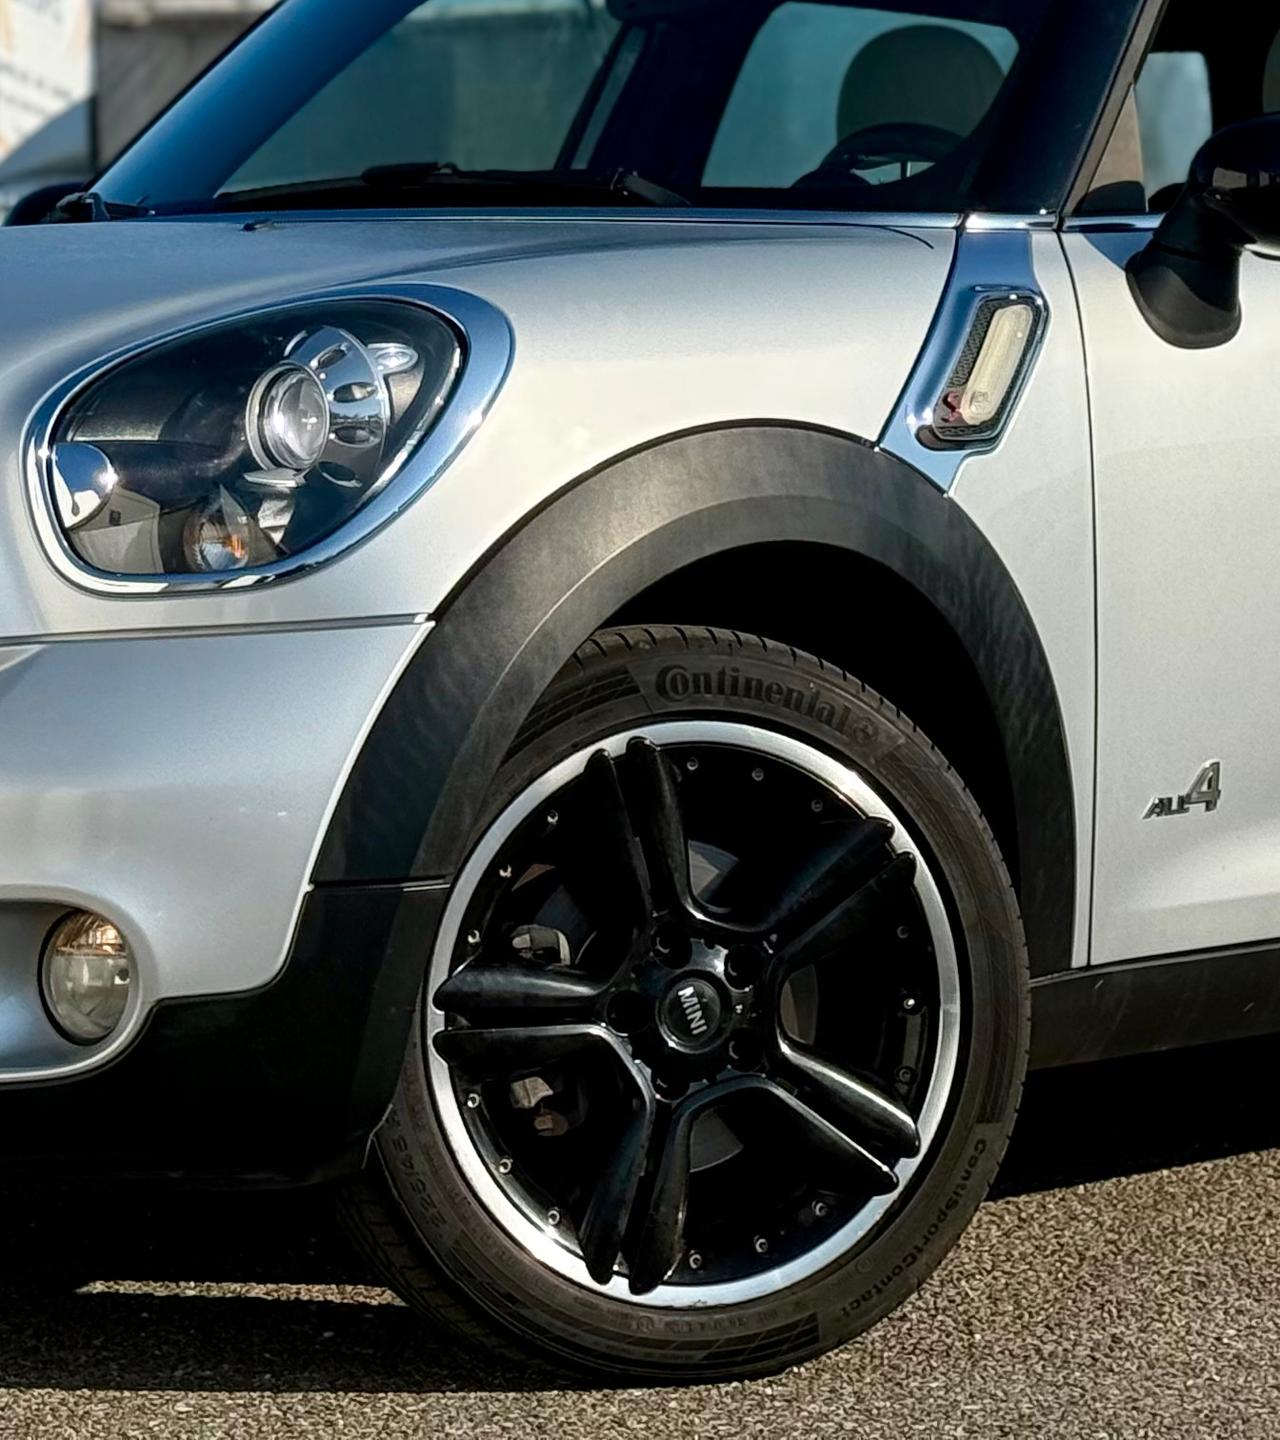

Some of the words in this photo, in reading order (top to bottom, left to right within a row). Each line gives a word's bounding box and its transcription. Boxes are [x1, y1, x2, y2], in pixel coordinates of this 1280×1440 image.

[655, 664, 852, 736] Continental
[678, 986, 708, 1035] MINI
[841, 1138, 987, 1318] ContiSportContact
